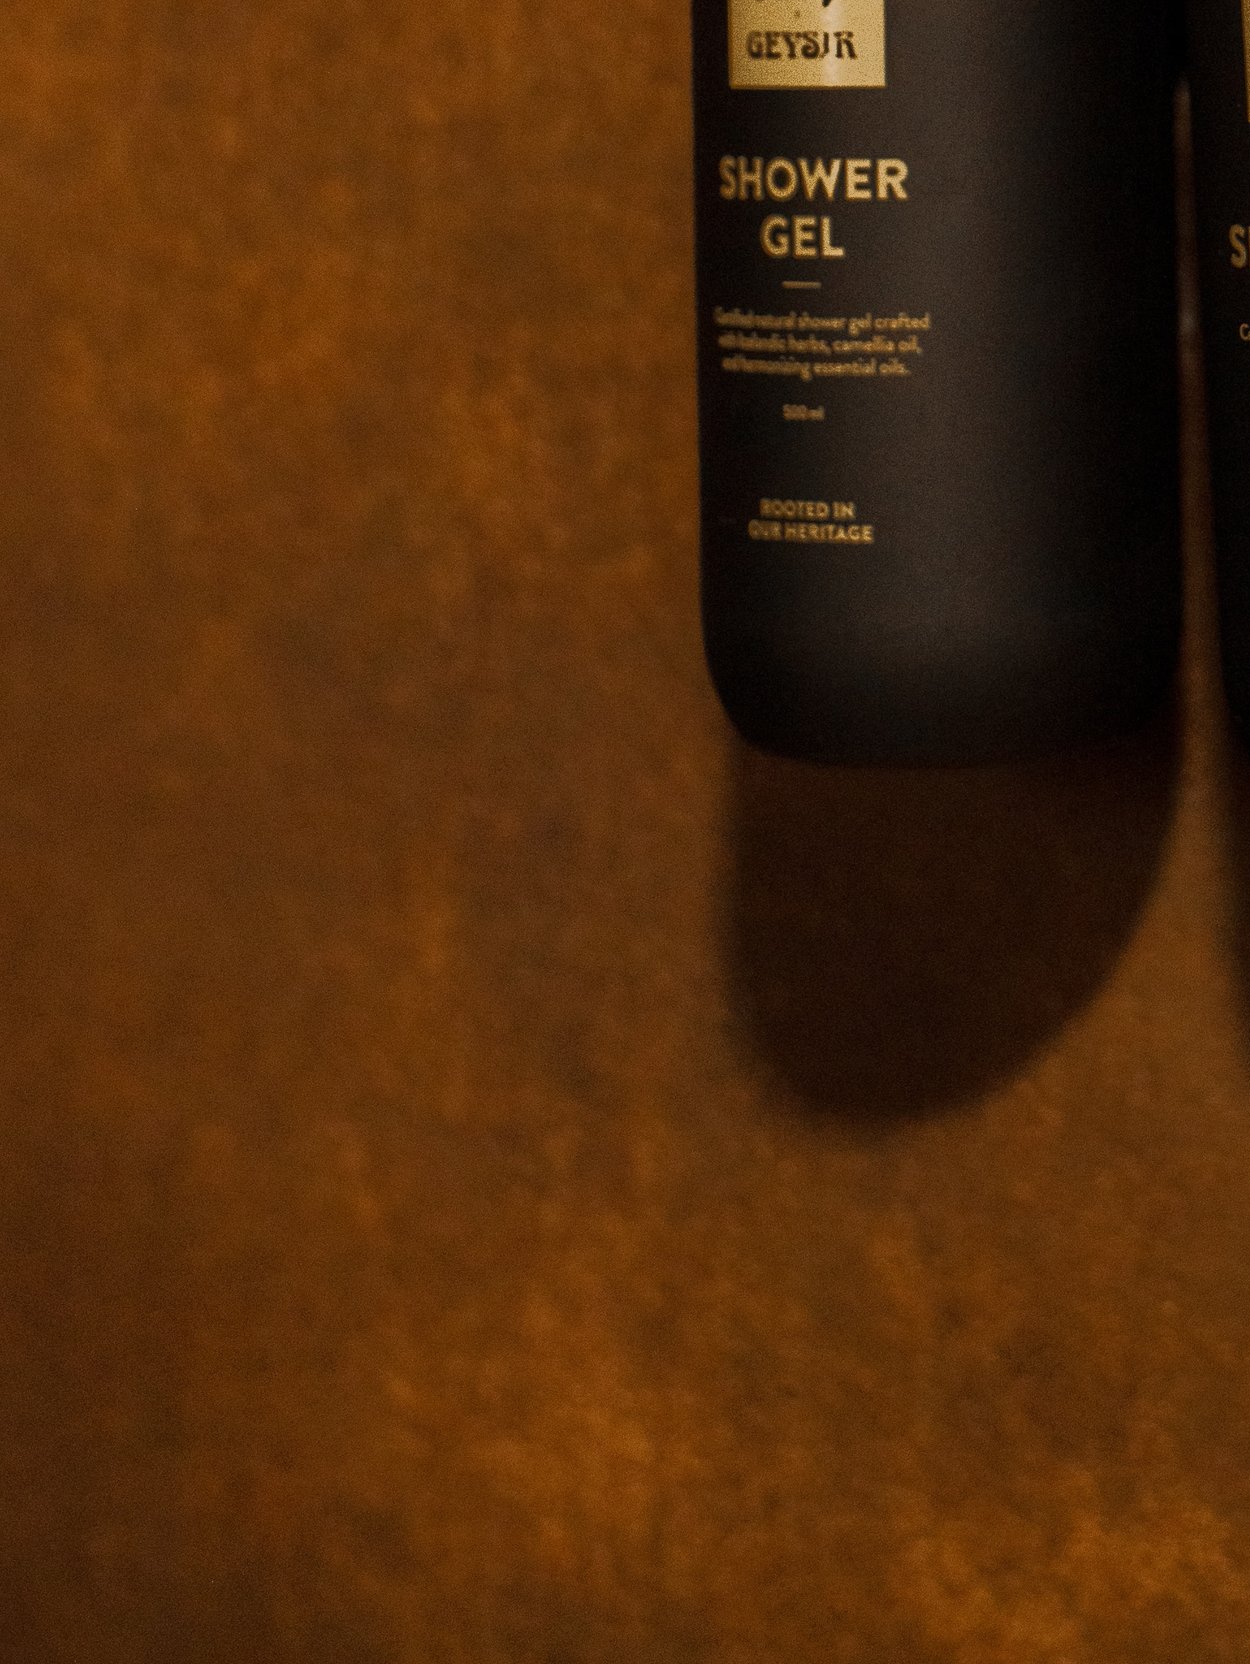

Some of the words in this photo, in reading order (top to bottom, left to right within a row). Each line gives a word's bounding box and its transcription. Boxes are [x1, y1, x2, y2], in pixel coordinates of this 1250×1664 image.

[718, 155, 909, 202] SHOWER
[760, 215, 845, 258] GEL
[874, 312, 931, 330] crafted
[760, 498, 829, 519] ROOTED
[832, 502, 854, 520] IN
[784, 524, 873, 545] HERITAGE
